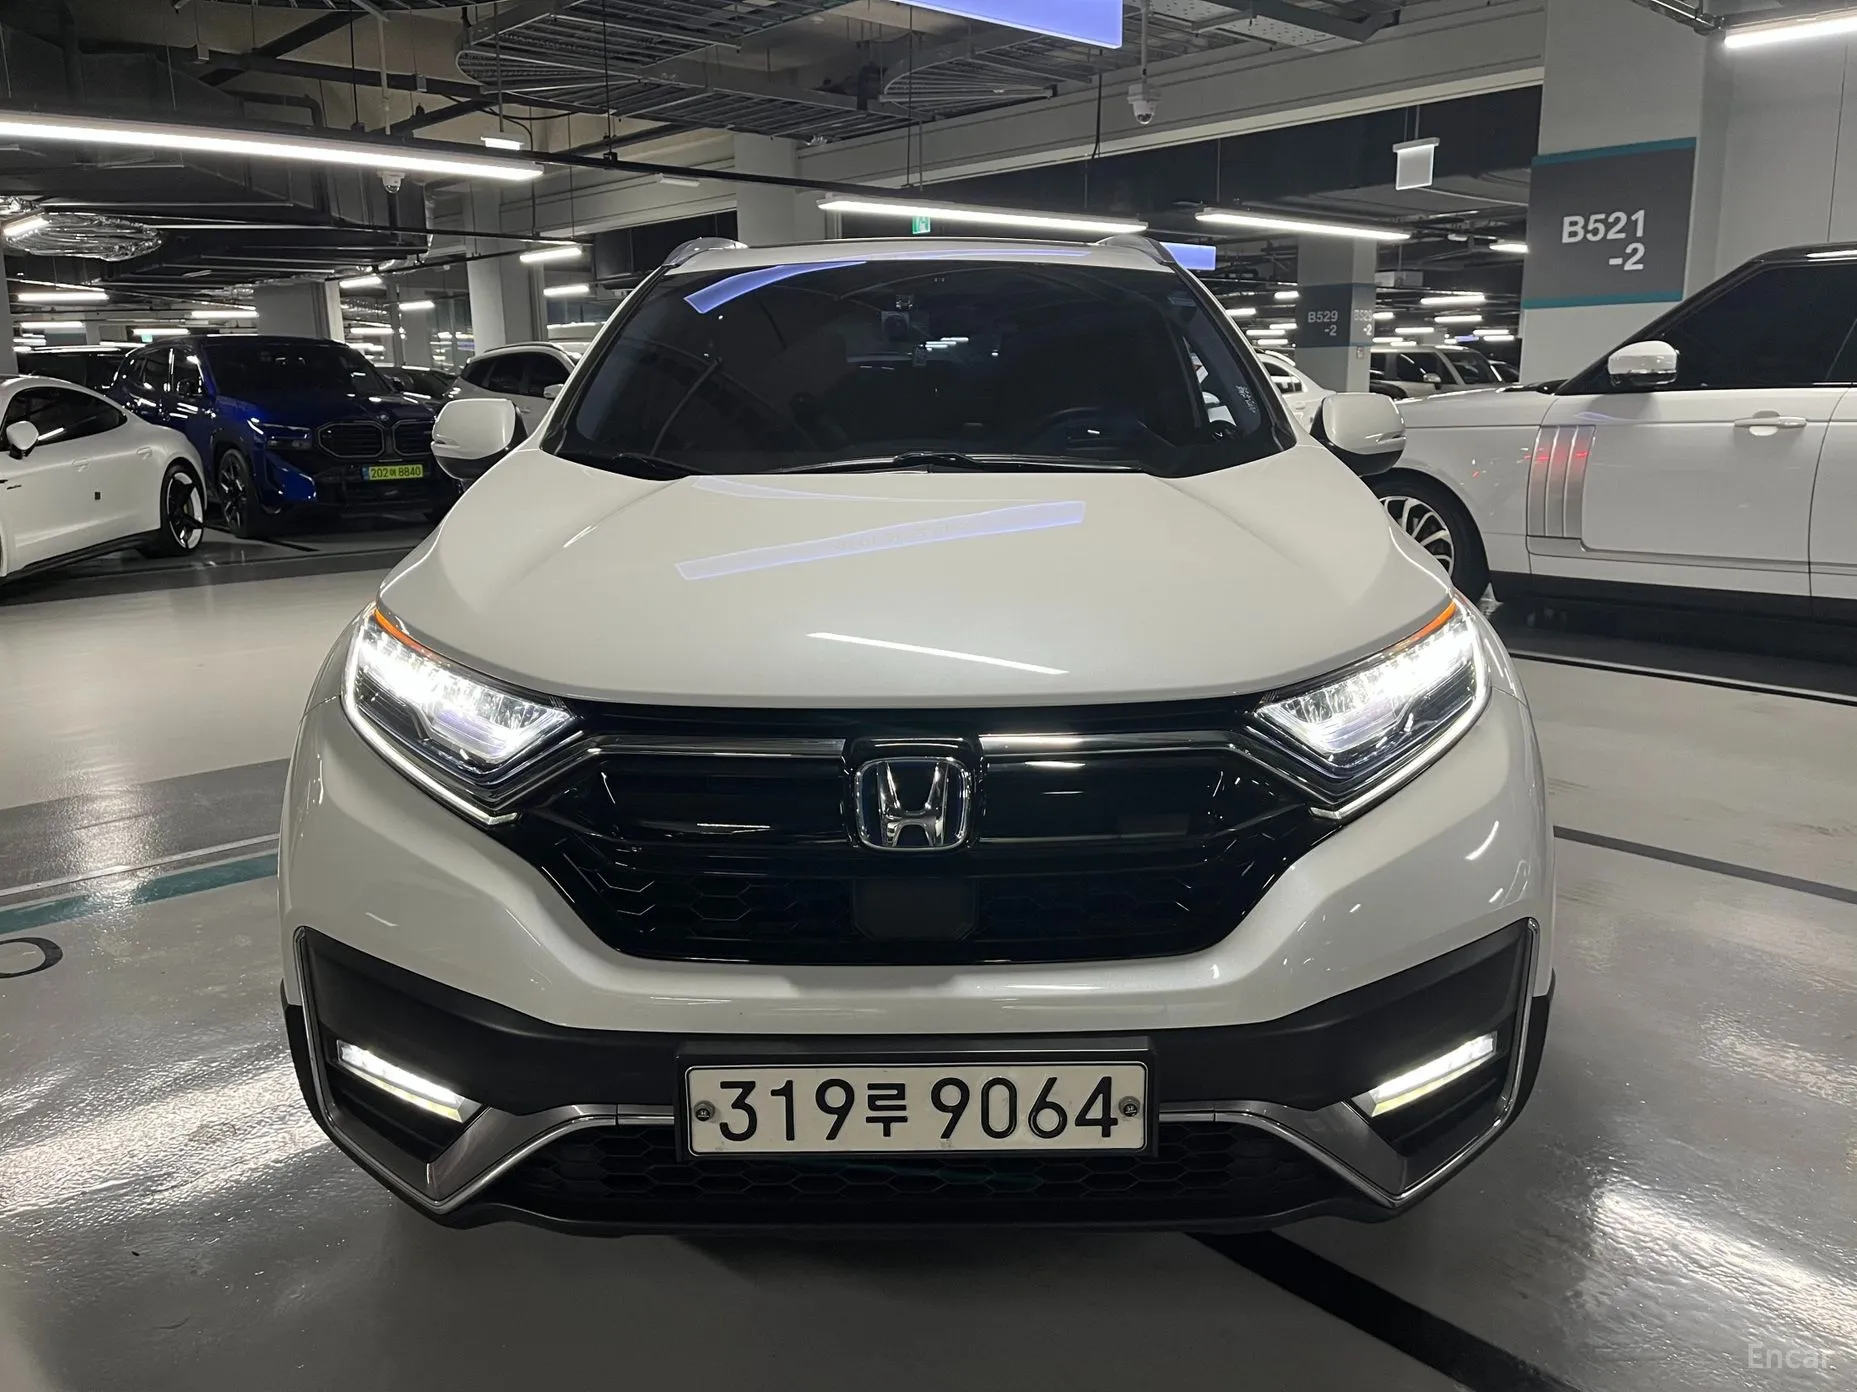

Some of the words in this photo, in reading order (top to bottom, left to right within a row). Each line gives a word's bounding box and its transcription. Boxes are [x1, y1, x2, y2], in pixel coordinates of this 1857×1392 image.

[1562, 210, 1645, 243] B521
[1609, 242, 1645, 270] -2
[1307, 310, 1338, 323] B529
[1324, 324, 1337, 336] -2
[1363, 323, 1372, 336] -2
[930, 1076, 1118, 1140] 9064
